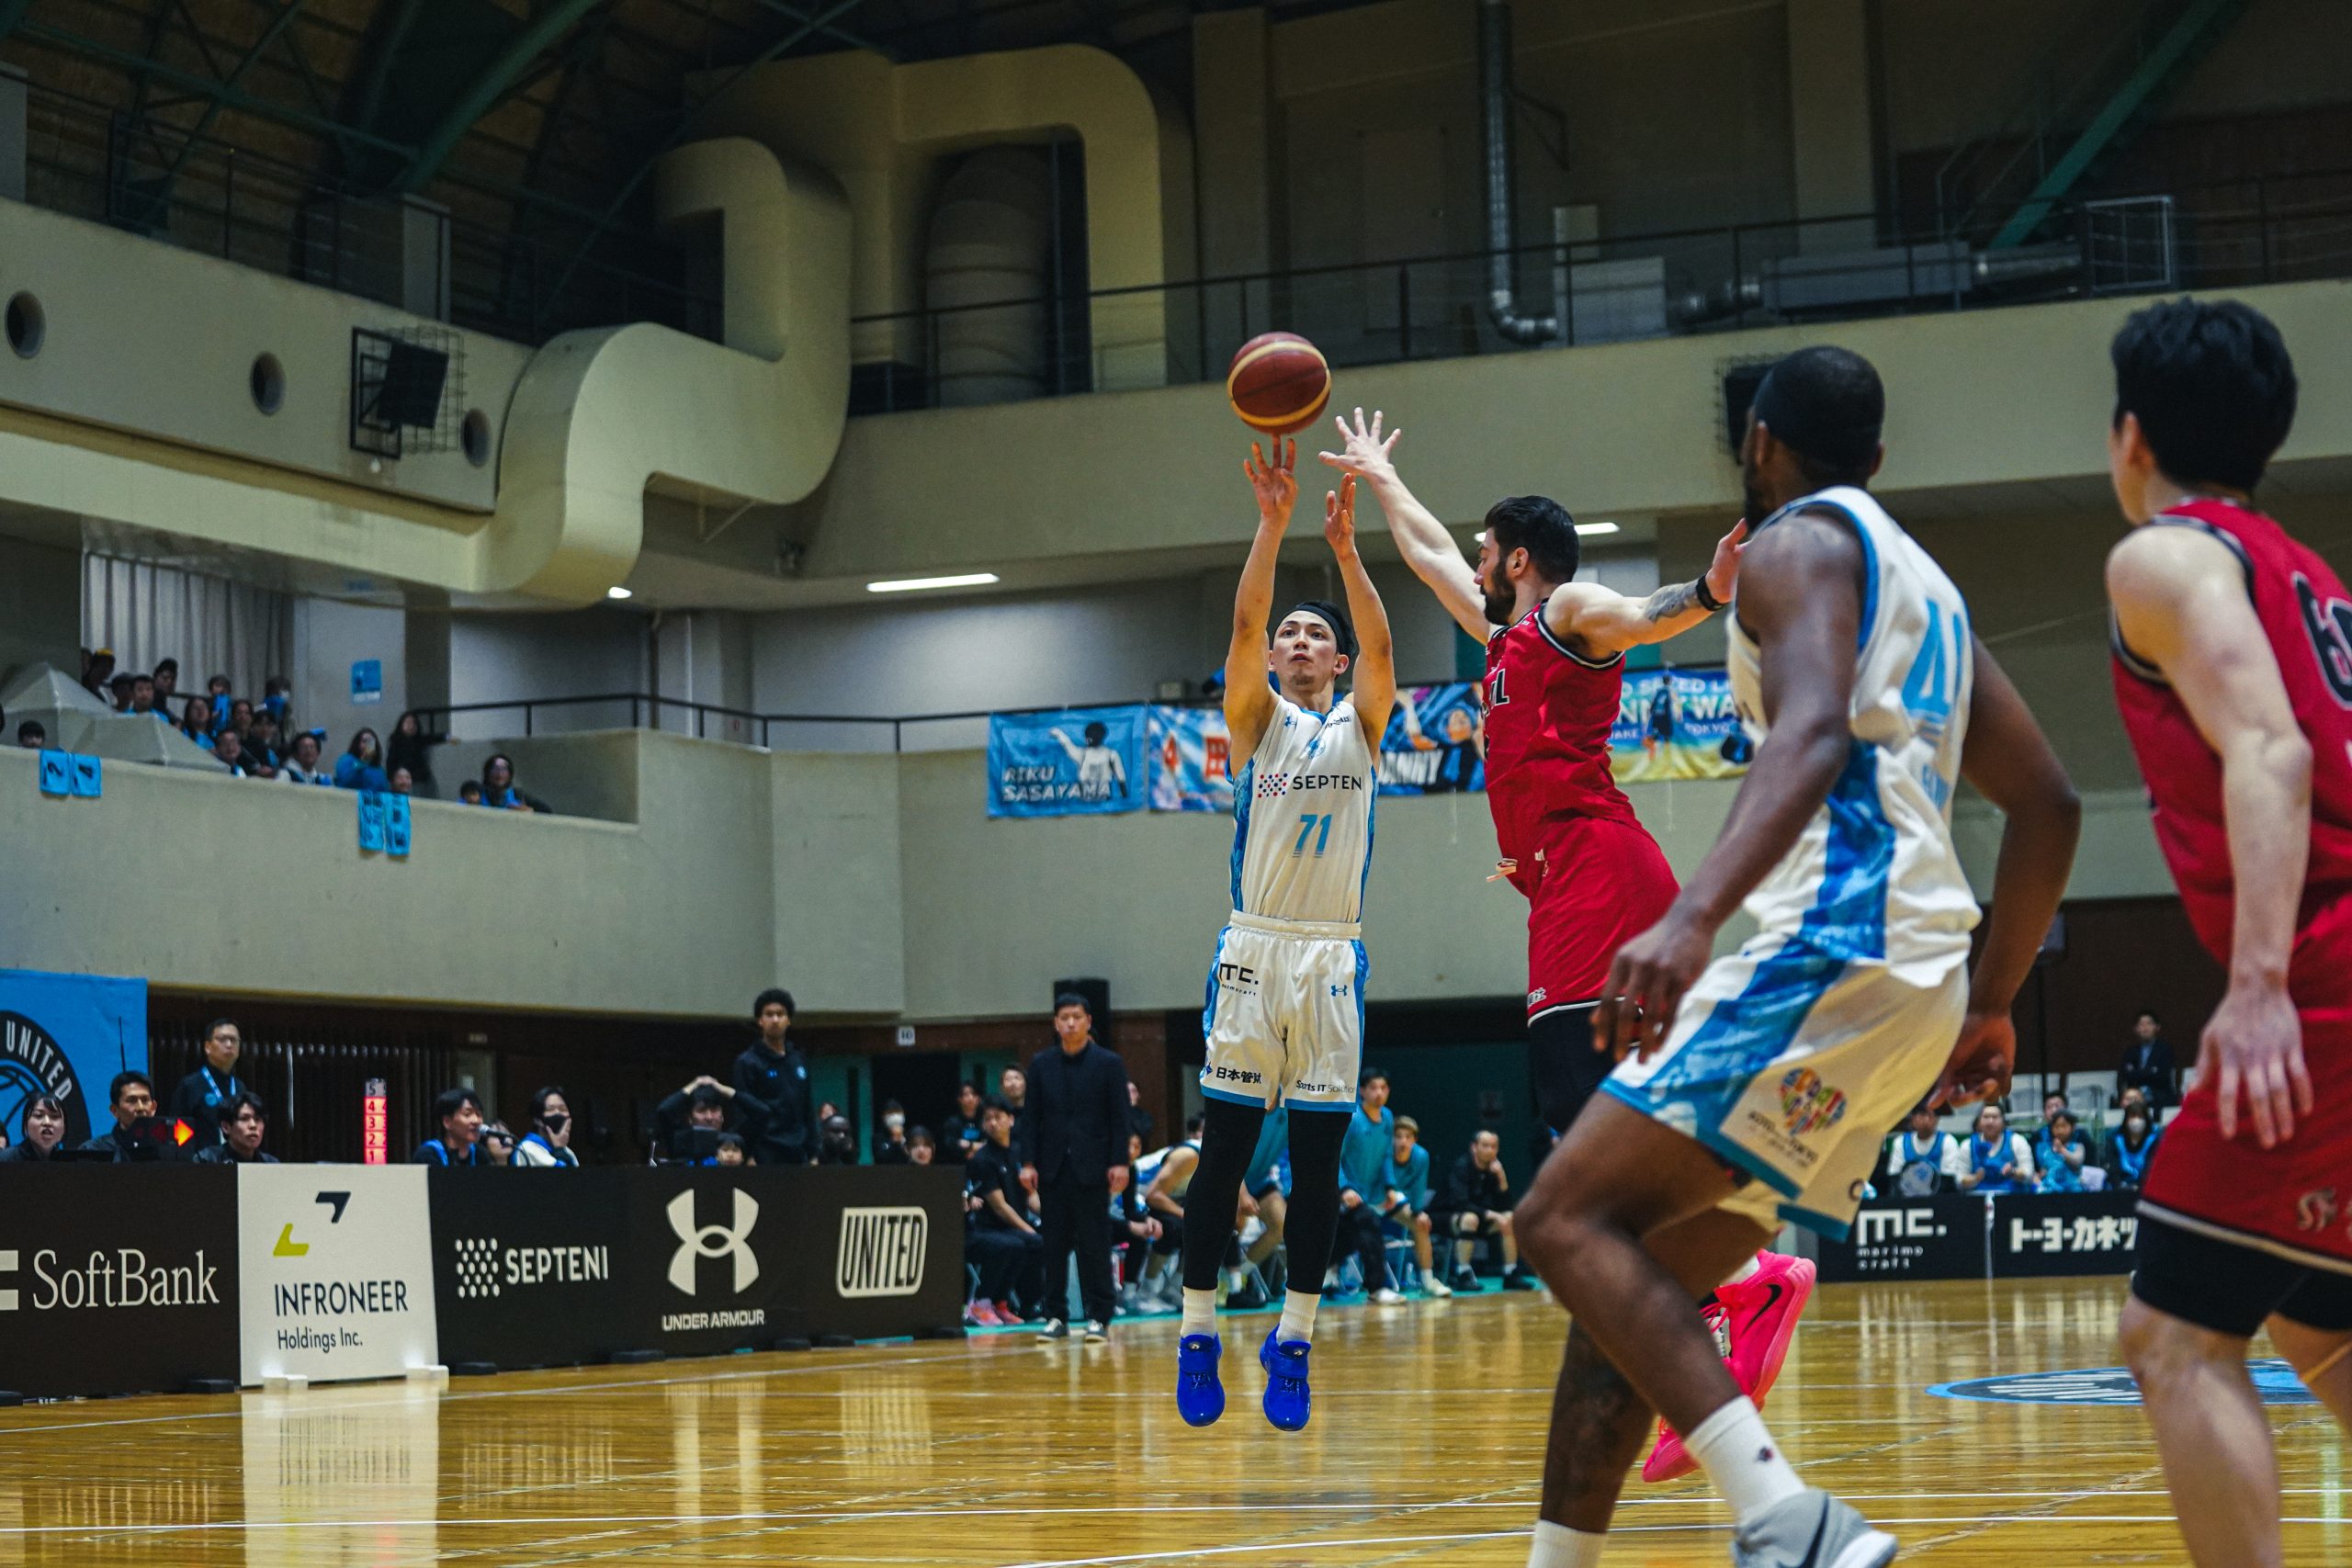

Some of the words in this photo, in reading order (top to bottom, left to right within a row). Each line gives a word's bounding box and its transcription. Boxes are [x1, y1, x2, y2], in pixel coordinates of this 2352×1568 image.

[1004, 765, 1055, 782] RIKU
[1292, 814, 1333, 858] 71
[6, 1020, 73, 1100] UNITED
[1317, 1084, 1327, 1092] IT
[505, 1246, 608, 1285] SEPTENI
[842, 1213, 924, 1290] UNITED
[1857, 1245, 1923, 1258] marimo
[33, 1248, 220, 1310] SoftBank
[275, 1280, 408, 1316] INFRONEER
[662, 1312, 708, 1331] UNDER
[710, 1308, 764, 1328] ARMOUR
[277, 1325, 336, 1354] Holdings
[340, 1326, 363, 1347] Inc.
